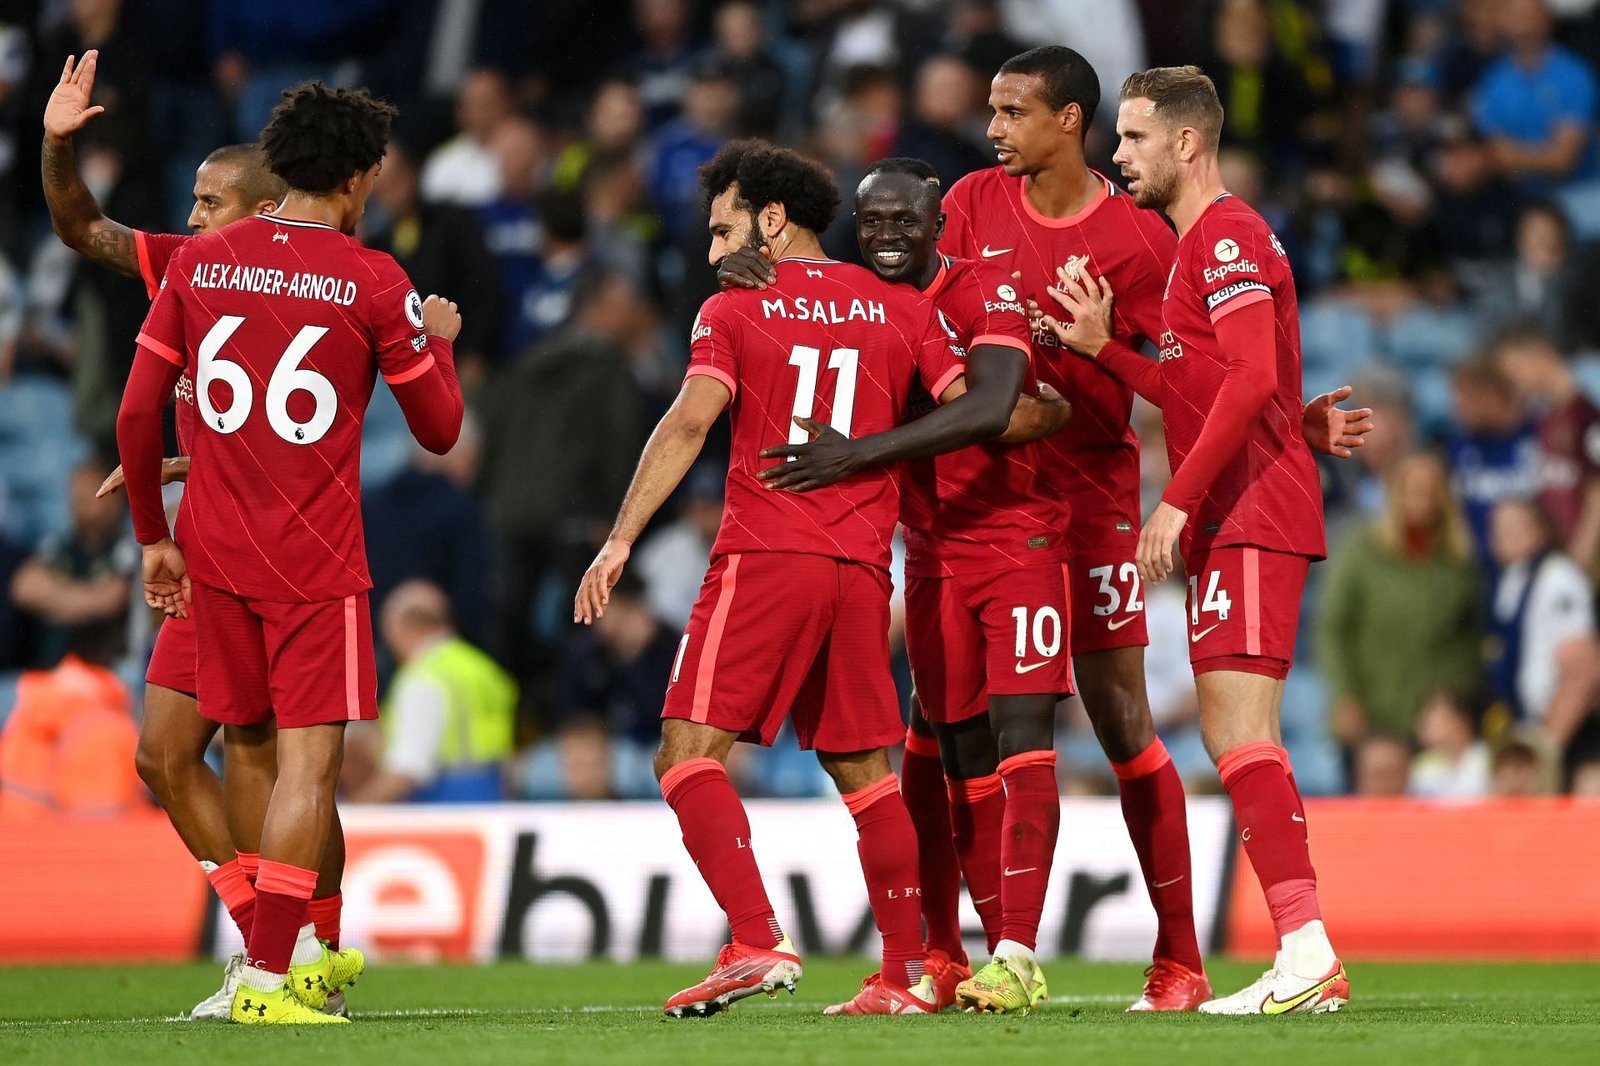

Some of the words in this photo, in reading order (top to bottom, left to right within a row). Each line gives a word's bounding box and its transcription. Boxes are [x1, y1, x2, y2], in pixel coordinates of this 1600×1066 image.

[190, 262, 357, 306] ALEXANDER-ARNOLD
[1203, 258, 1259, 284] Expedia
[761, 298, 886, 325] M.SALAH
[197, 314, 339, 445] 66
[787, 344, 860, 463] 11
[1088, 561, 1144, 617] 32
[1188, 569, 1232, 626] 14
[1011, 605, 1063, 658] 10
